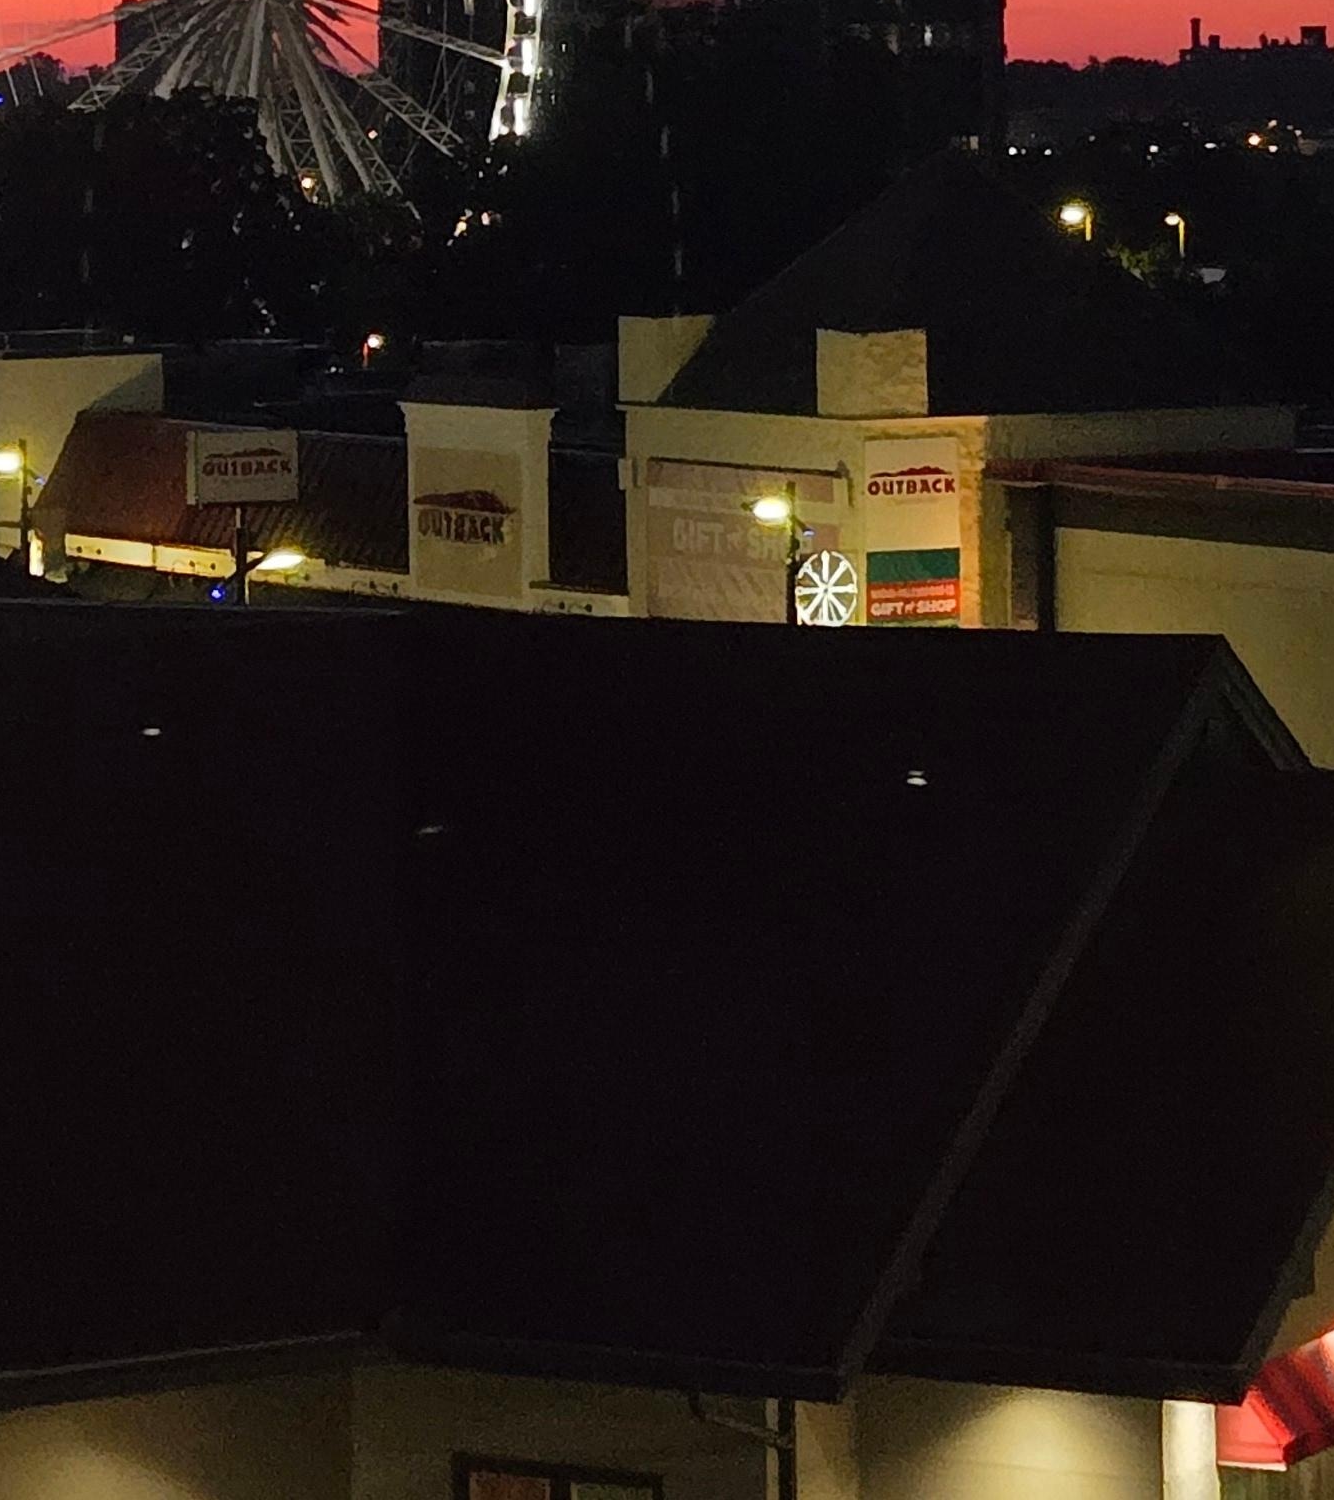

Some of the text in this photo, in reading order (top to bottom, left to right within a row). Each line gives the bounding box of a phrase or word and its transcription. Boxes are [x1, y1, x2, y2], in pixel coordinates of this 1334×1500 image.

[202, 459, 293, 477] OUTBACK
[867, 477, 956, 496] OUTBACK
[417, 508, 506, 545] OUTBACK
[870, 601, 904, 617] GIFT
[916, 598, 957, 614] SHOP
